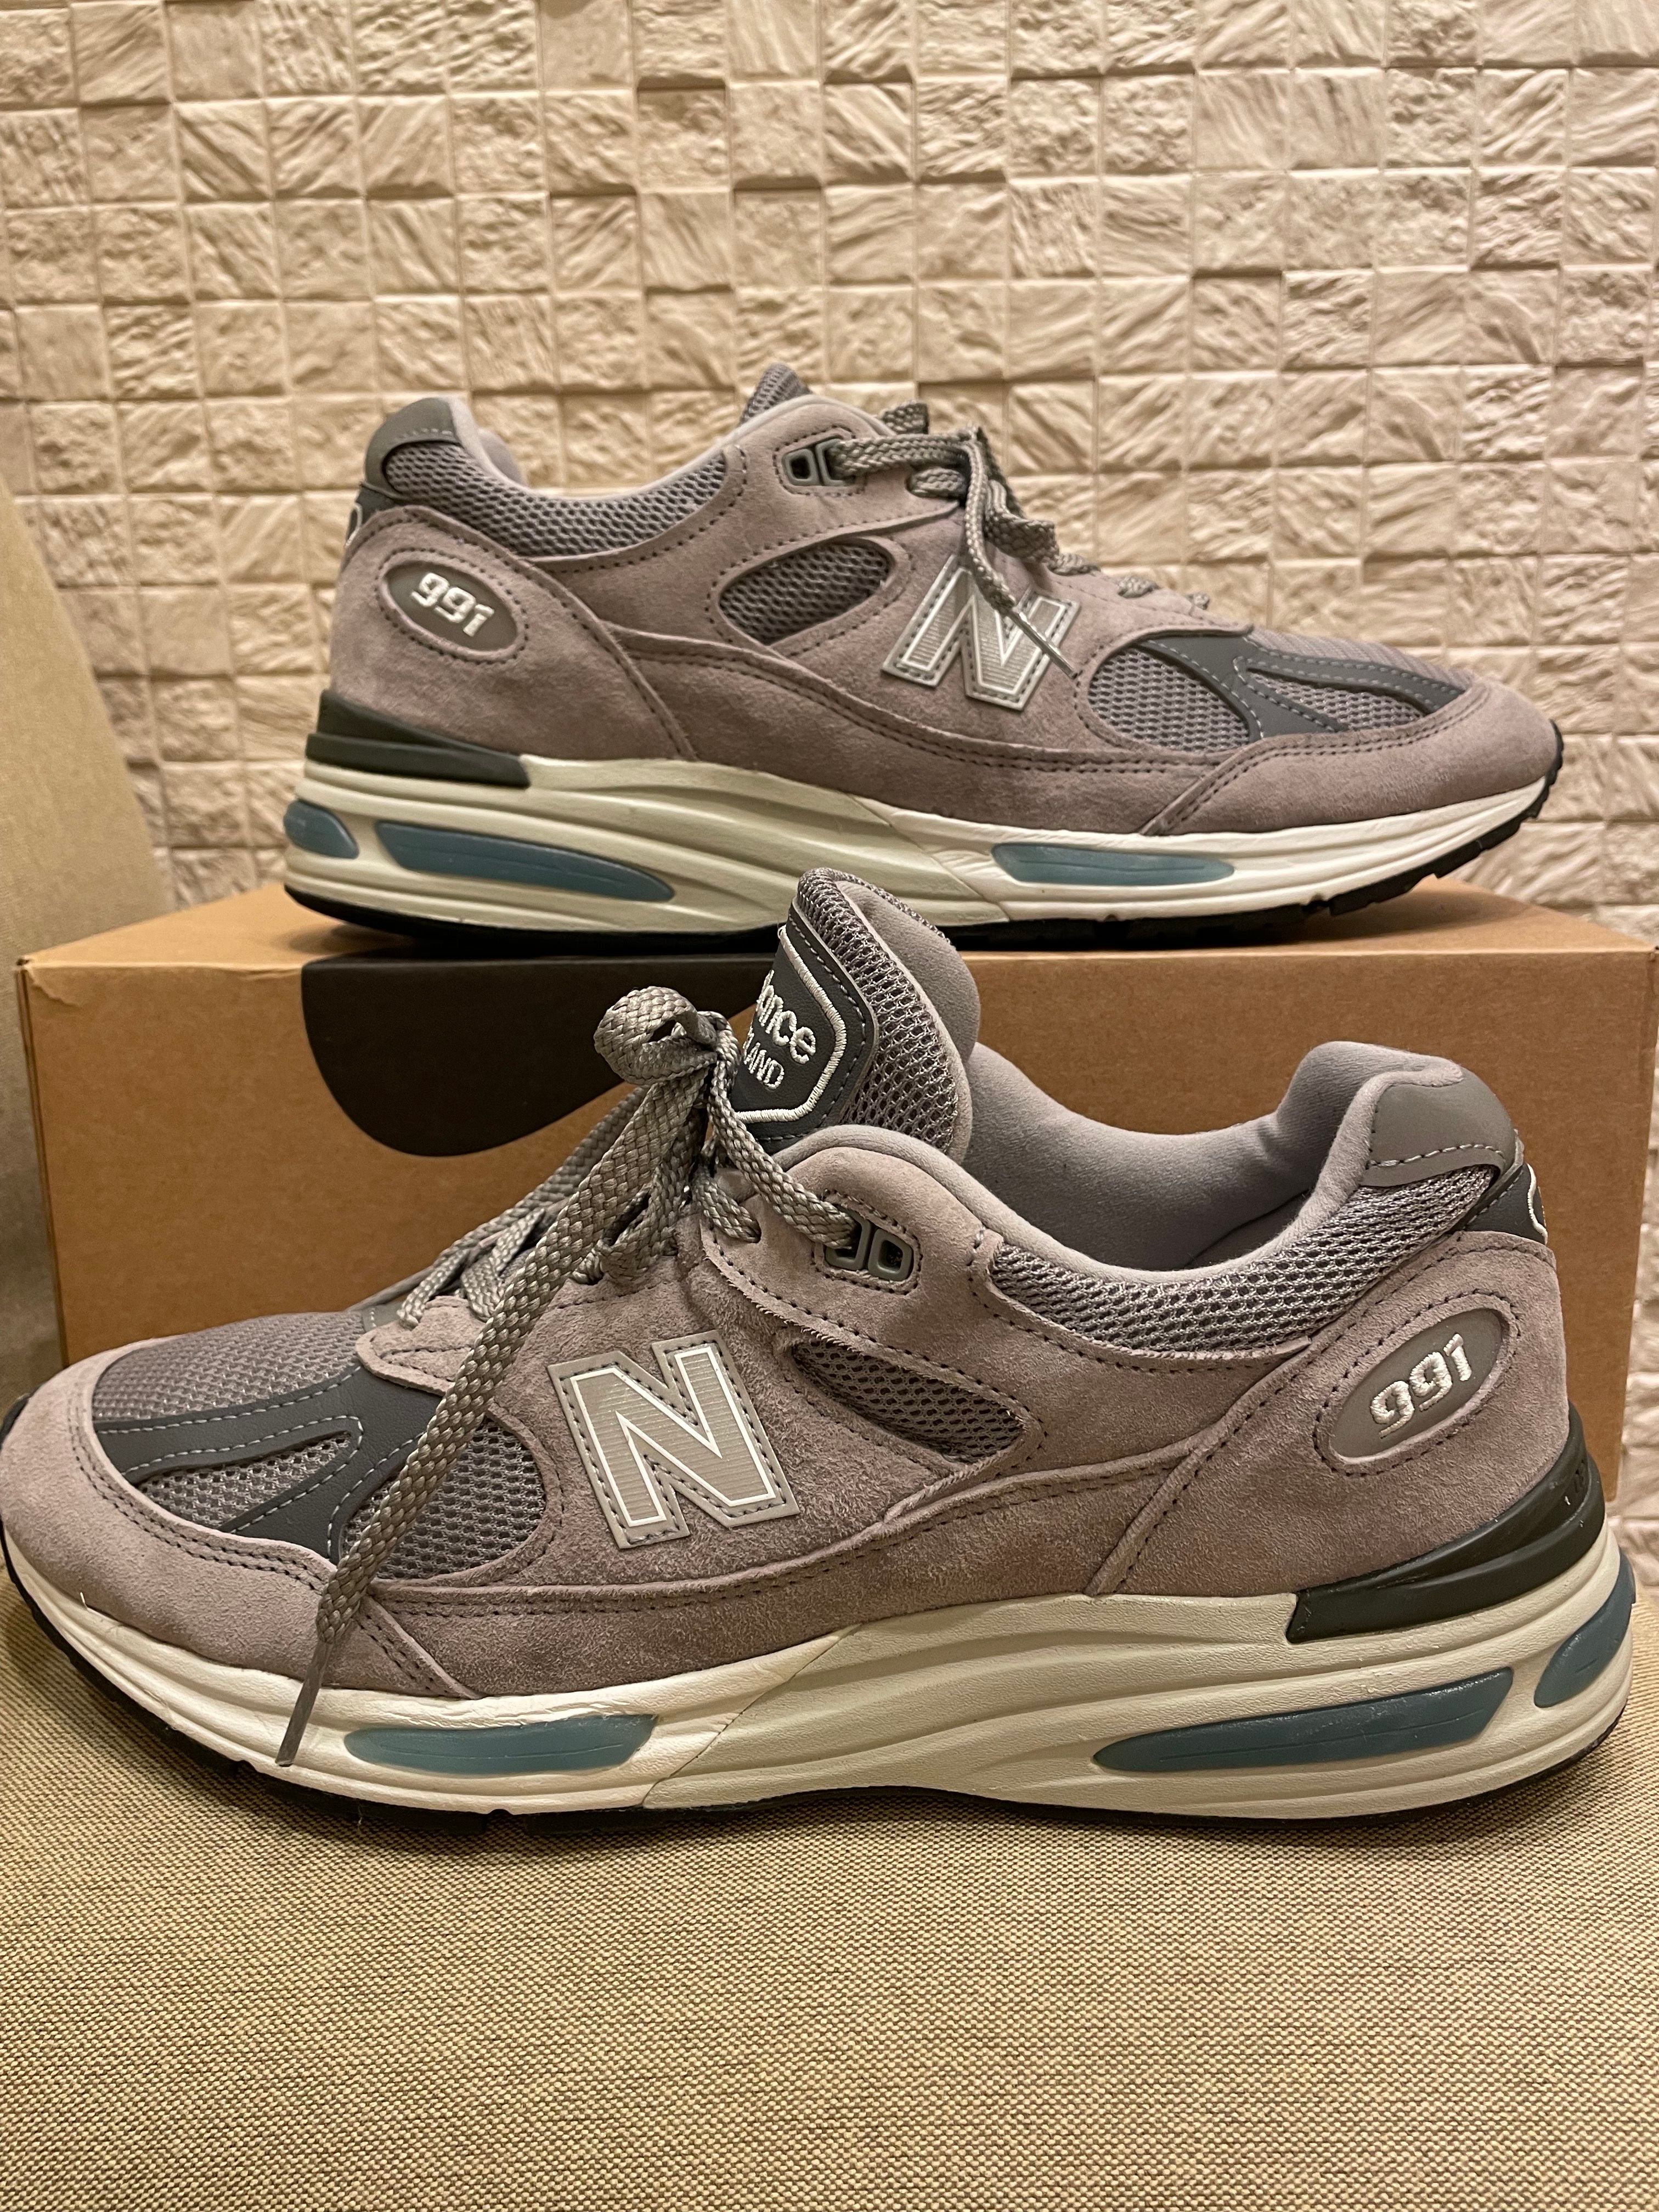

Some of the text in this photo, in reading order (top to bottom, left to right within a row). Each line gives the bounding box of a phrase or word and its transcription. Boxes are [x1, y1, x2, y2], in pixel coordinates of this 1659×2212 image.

[411, 572, 495, 637] 991
[881, 554, 1081, 711] N
[547, 1329, 800, 1549] N
[1370, 1333, 1472, 1439] 991
